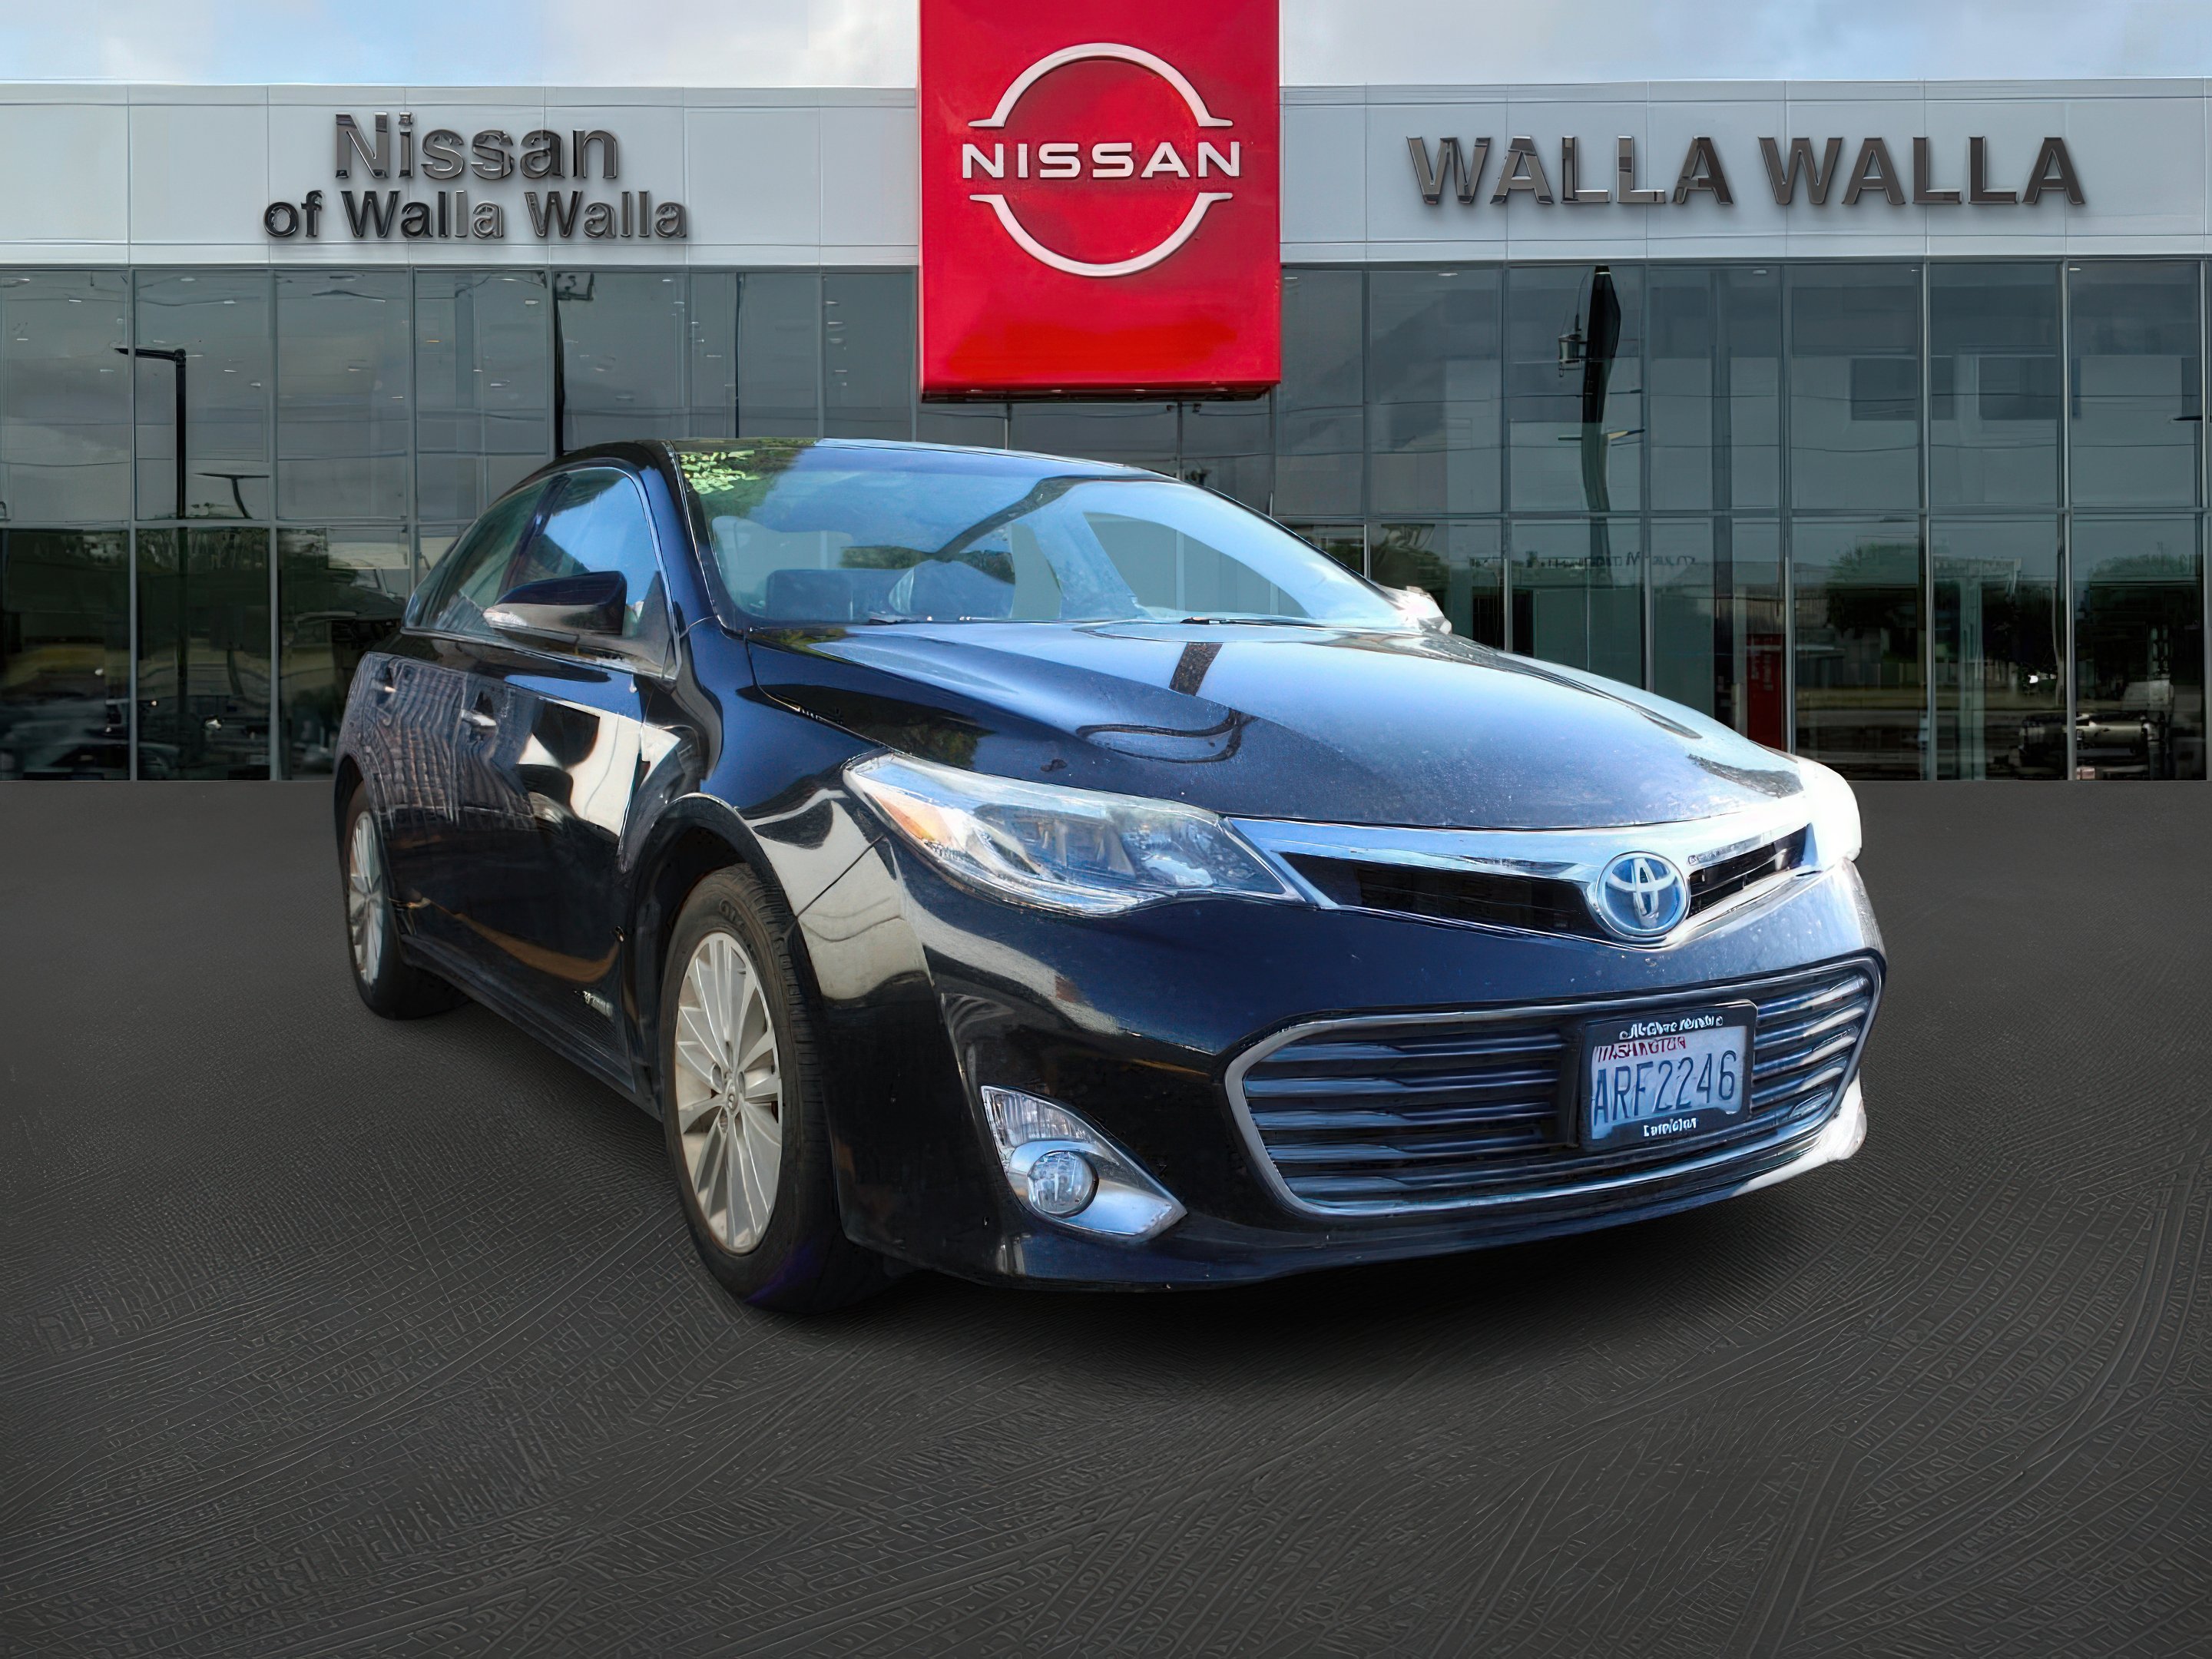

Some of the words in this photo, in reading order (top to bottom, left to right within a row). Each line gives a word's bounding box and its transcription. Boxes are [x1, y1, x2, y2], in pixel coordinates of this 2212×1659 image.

[335, 111, 618, 180] Nissan
[962, 141, 1240, 178] NISSAN
[1406, 135, 1734, 206] WALLA
[1757, 135, 2087, 206] WALLA
[263, 190, 323, 239] of
[340, 190, 505, 239] Walla
[523, 190, 688, 239] Walla
[1592, 1050, 1737, 1127] ARF2246
